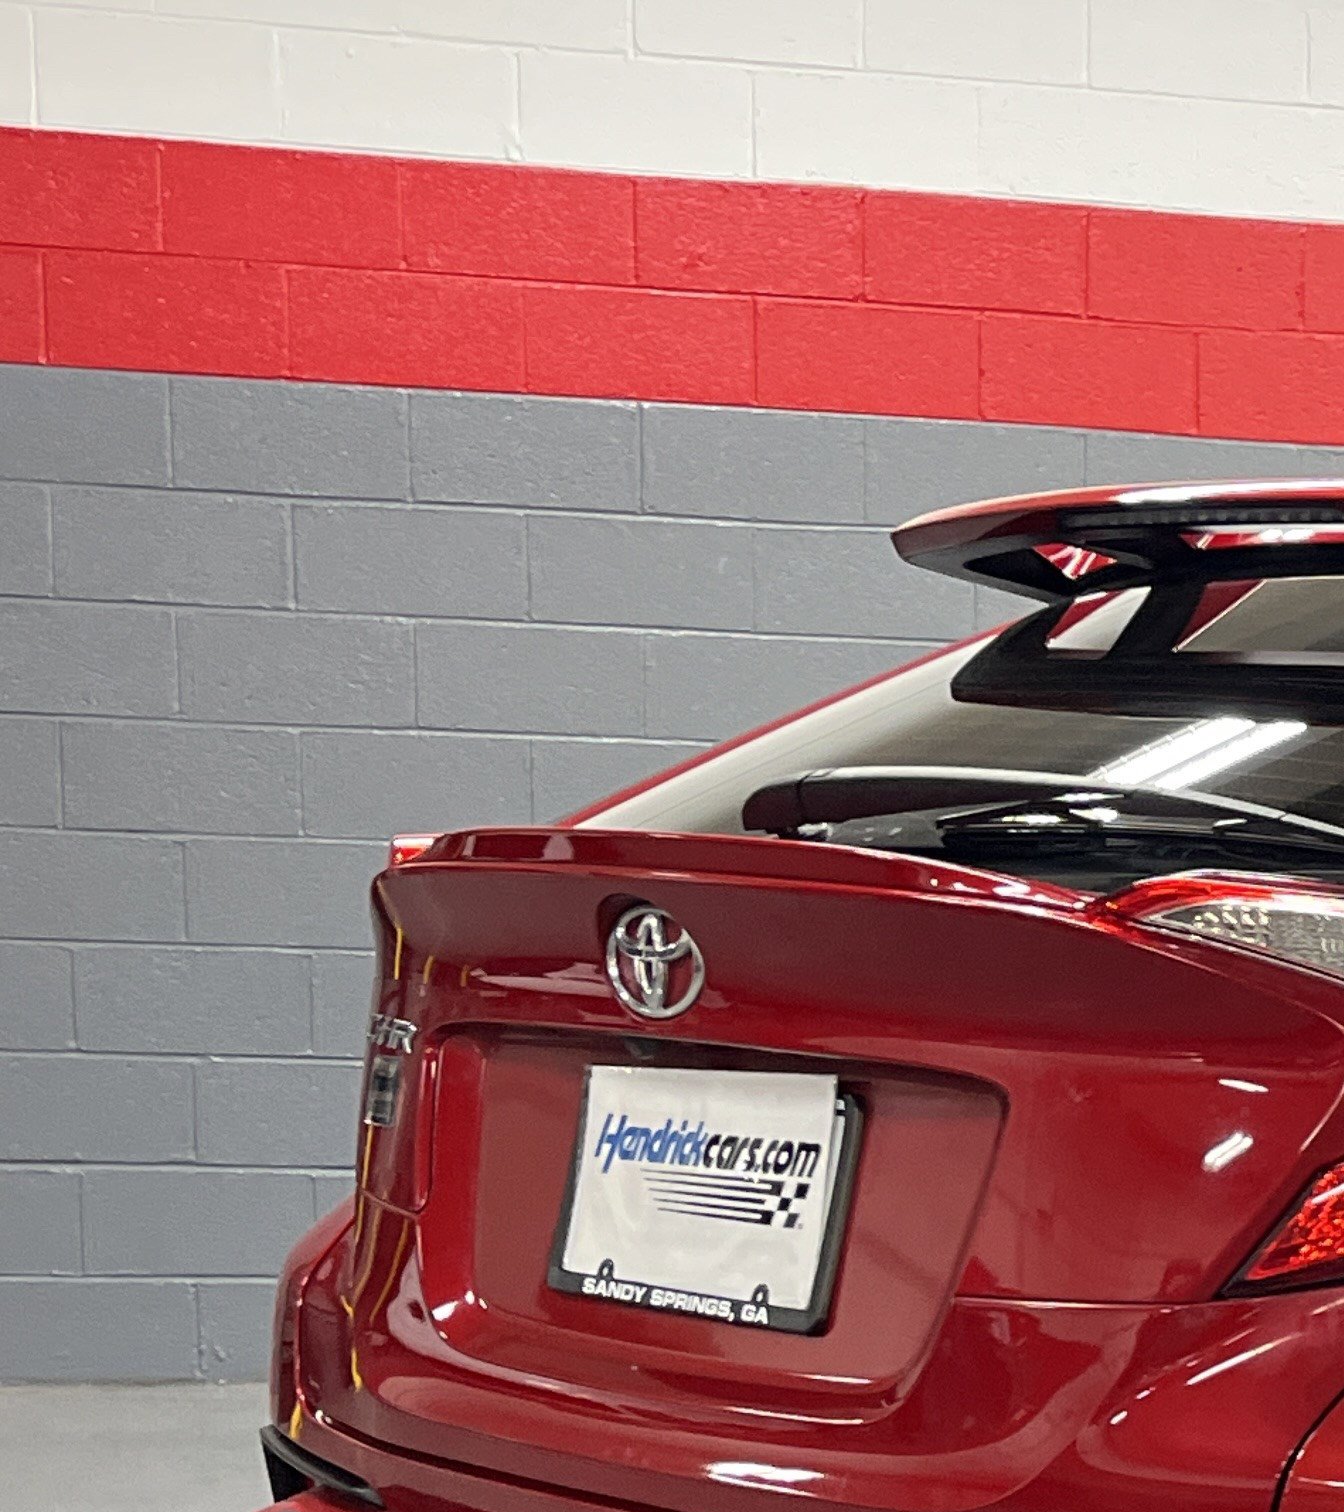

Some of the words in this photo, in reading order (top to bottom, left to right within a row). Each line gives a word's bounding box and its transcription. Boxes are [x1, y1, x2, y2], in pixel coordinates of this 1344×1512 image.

[594, 1114, 822, 1178] Hendrickcars.com
[582, 1277, 647, 1304] SANDY
[649, 1289, 735, 1322] SPRINGS,
[740, 1304, 769, 1325] GA
